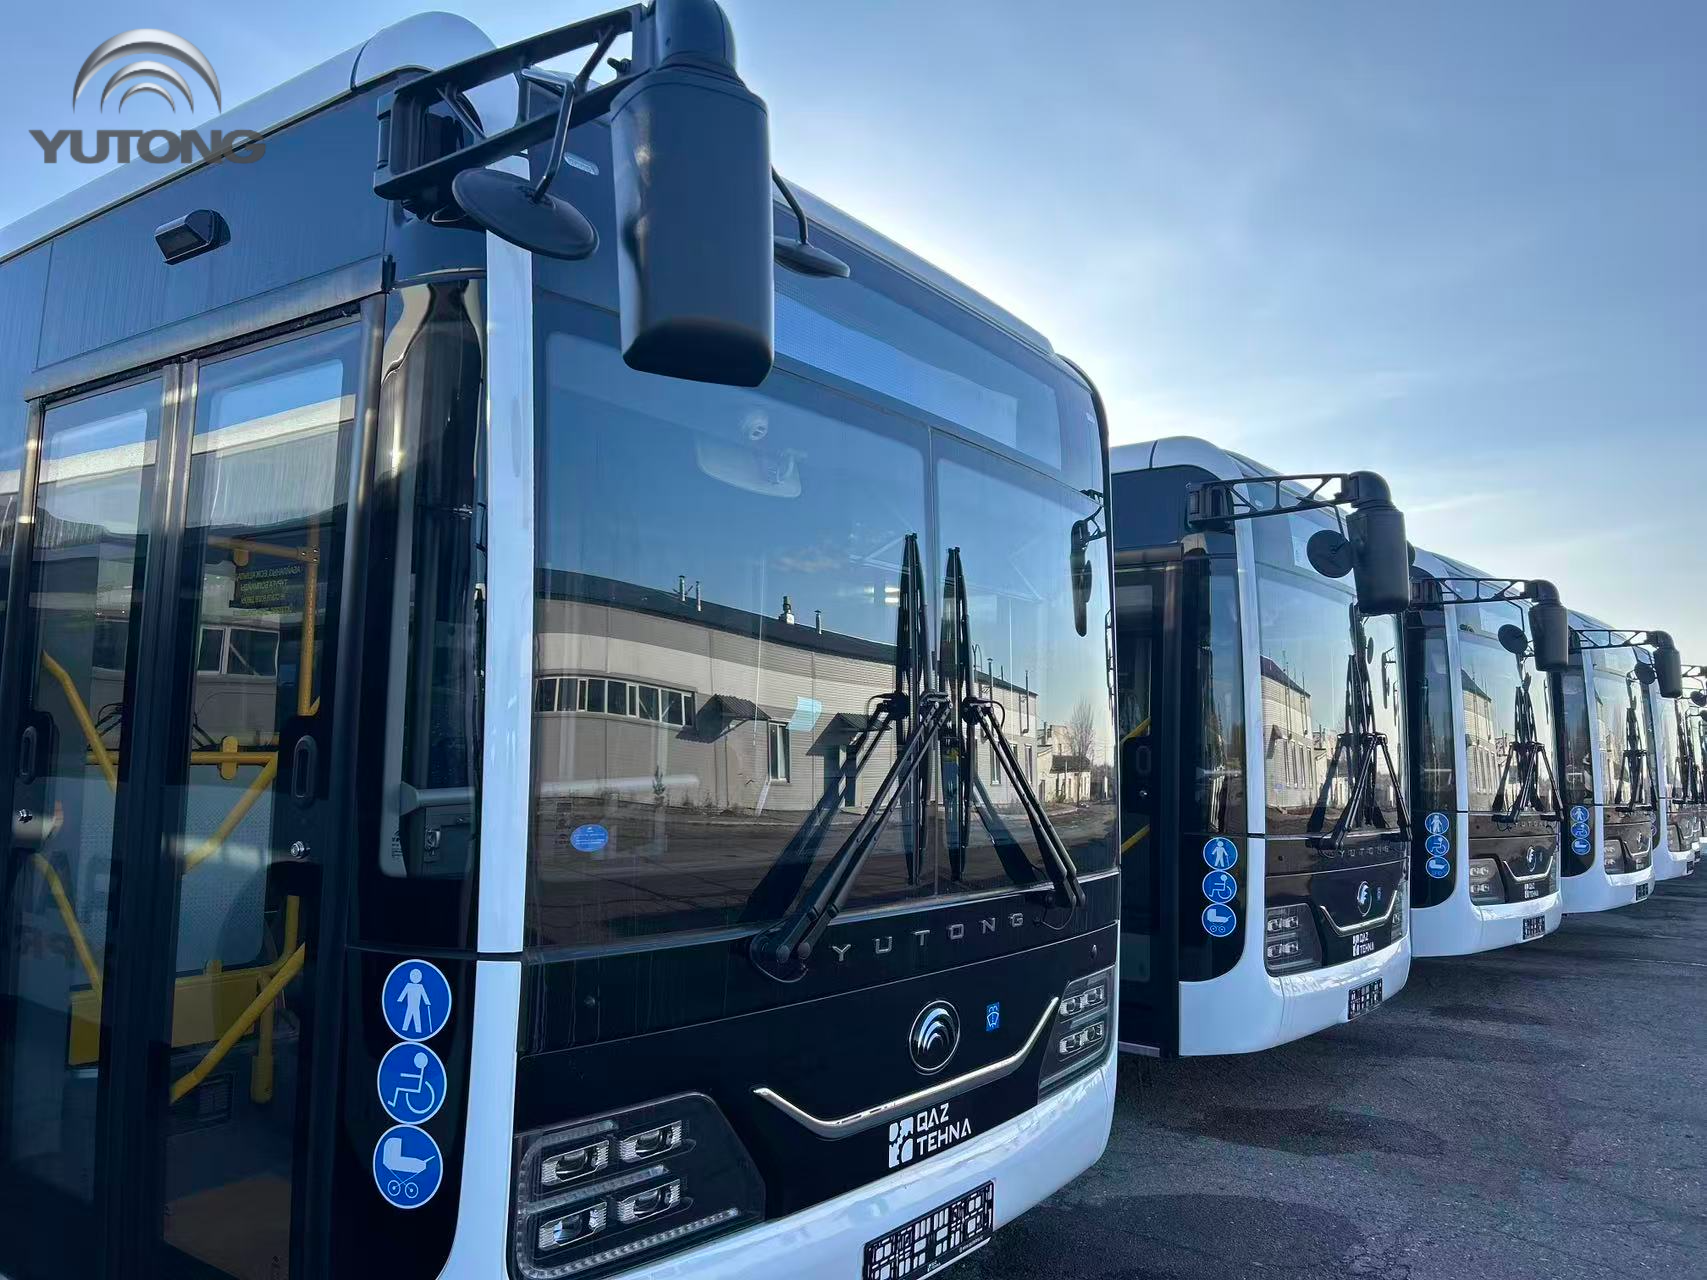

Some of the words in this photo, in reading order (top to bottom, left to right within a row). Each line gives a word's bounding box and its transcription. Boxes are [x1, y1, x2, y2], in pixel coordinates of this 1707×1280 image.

[831, 912, 1024, 962] YUTONG
[916, 1102, 950, 1133] QAZ
[916, 1118, 972, 1156] TEHNA
